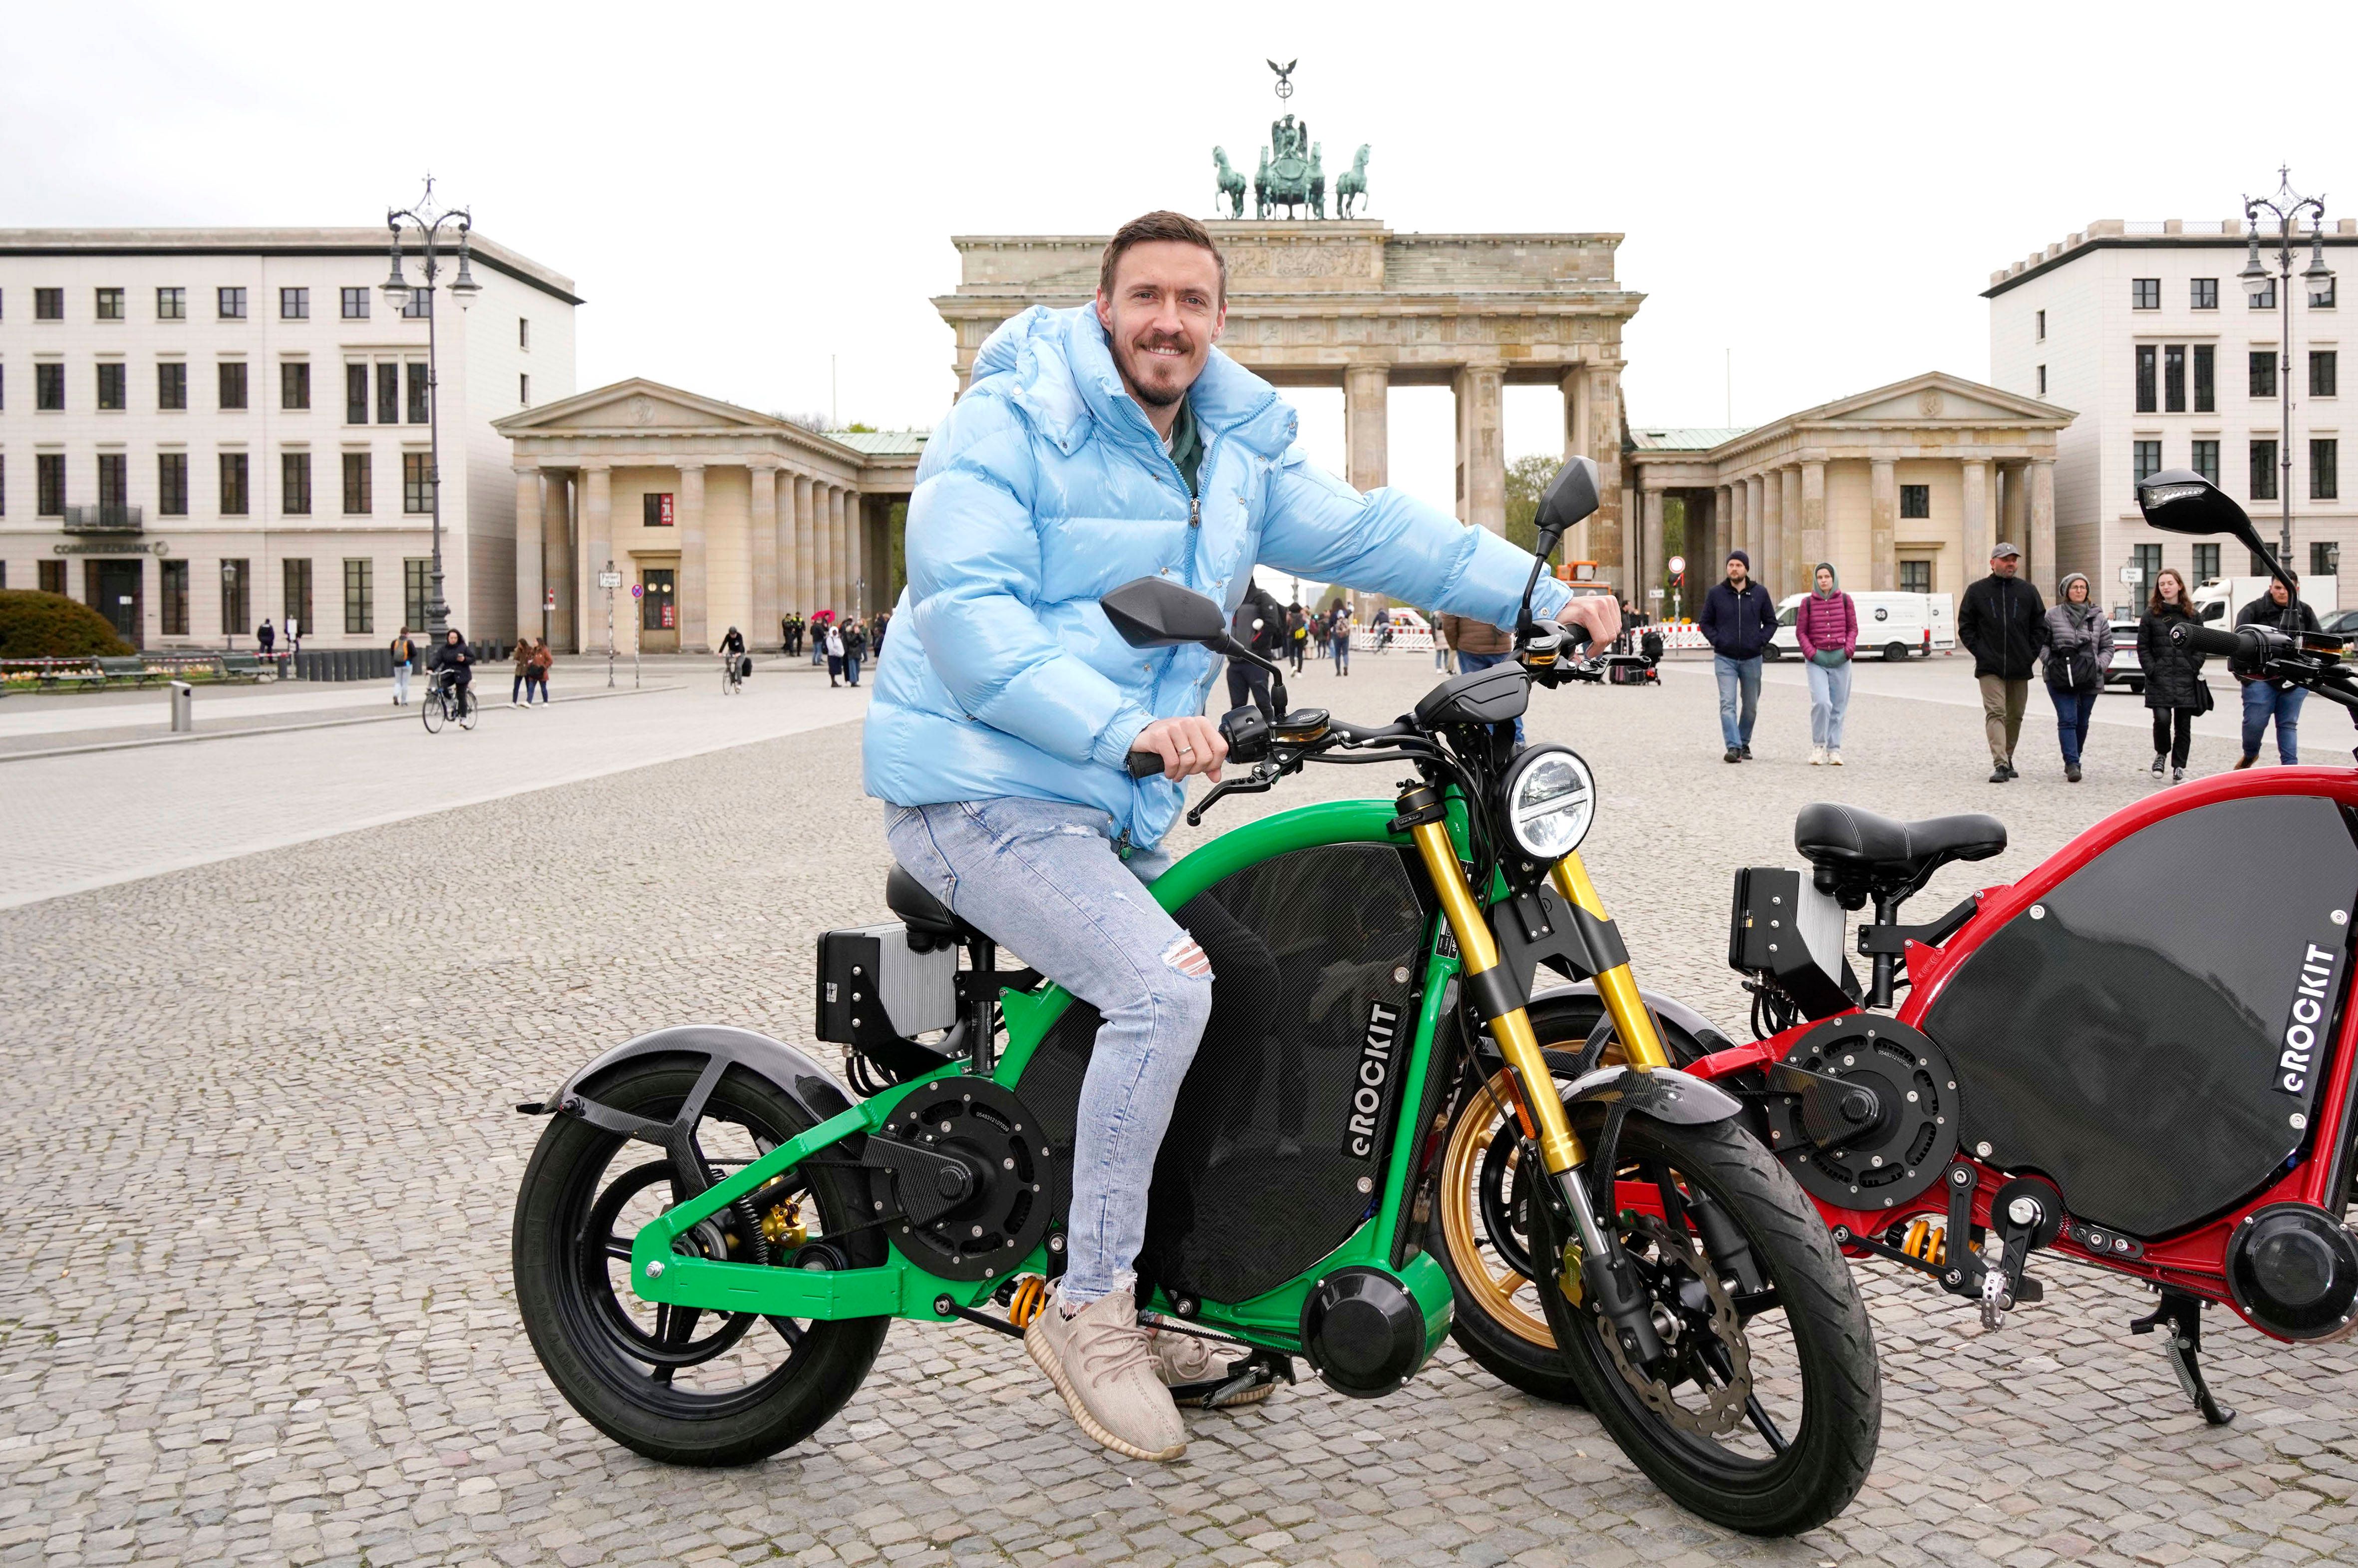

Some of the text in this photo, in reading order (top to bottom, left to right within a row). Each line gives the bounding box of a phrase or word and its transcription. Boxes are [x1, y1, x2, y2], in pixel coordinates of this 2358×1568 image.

[1349, 1004, 1396, 1156] eROCKIT
[1878, 1049, 1912, 1069] 0548312107045
[2276, 944, 2334, 1091] eROCKIT
